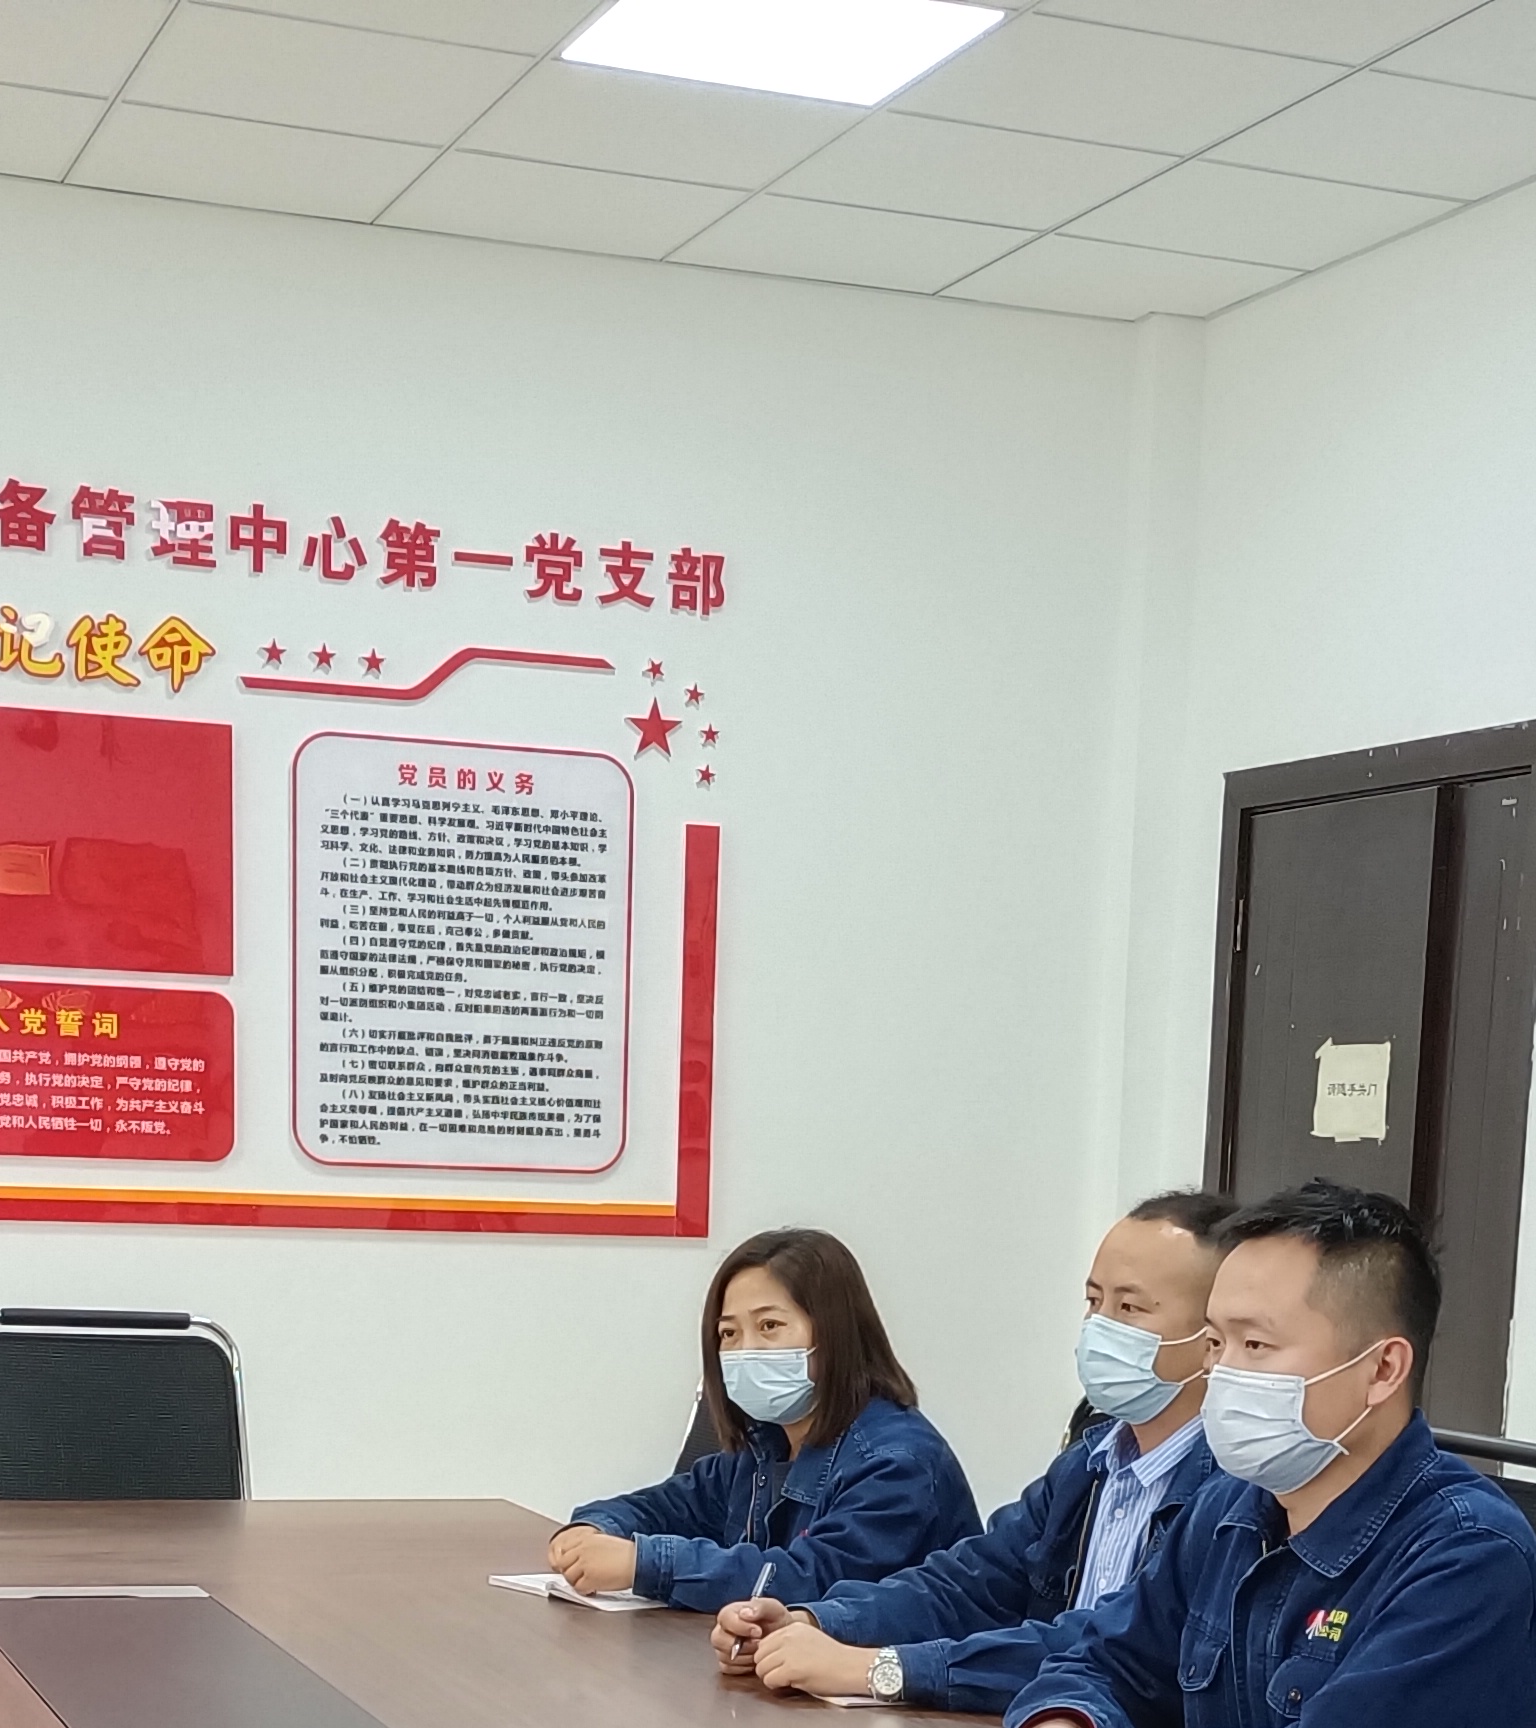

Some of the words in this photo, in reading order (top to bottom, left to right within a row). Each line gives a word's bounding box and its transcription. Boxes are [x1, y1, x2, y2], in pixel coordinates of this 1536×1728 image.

[398, 764, 534, 794] 党员的义务
